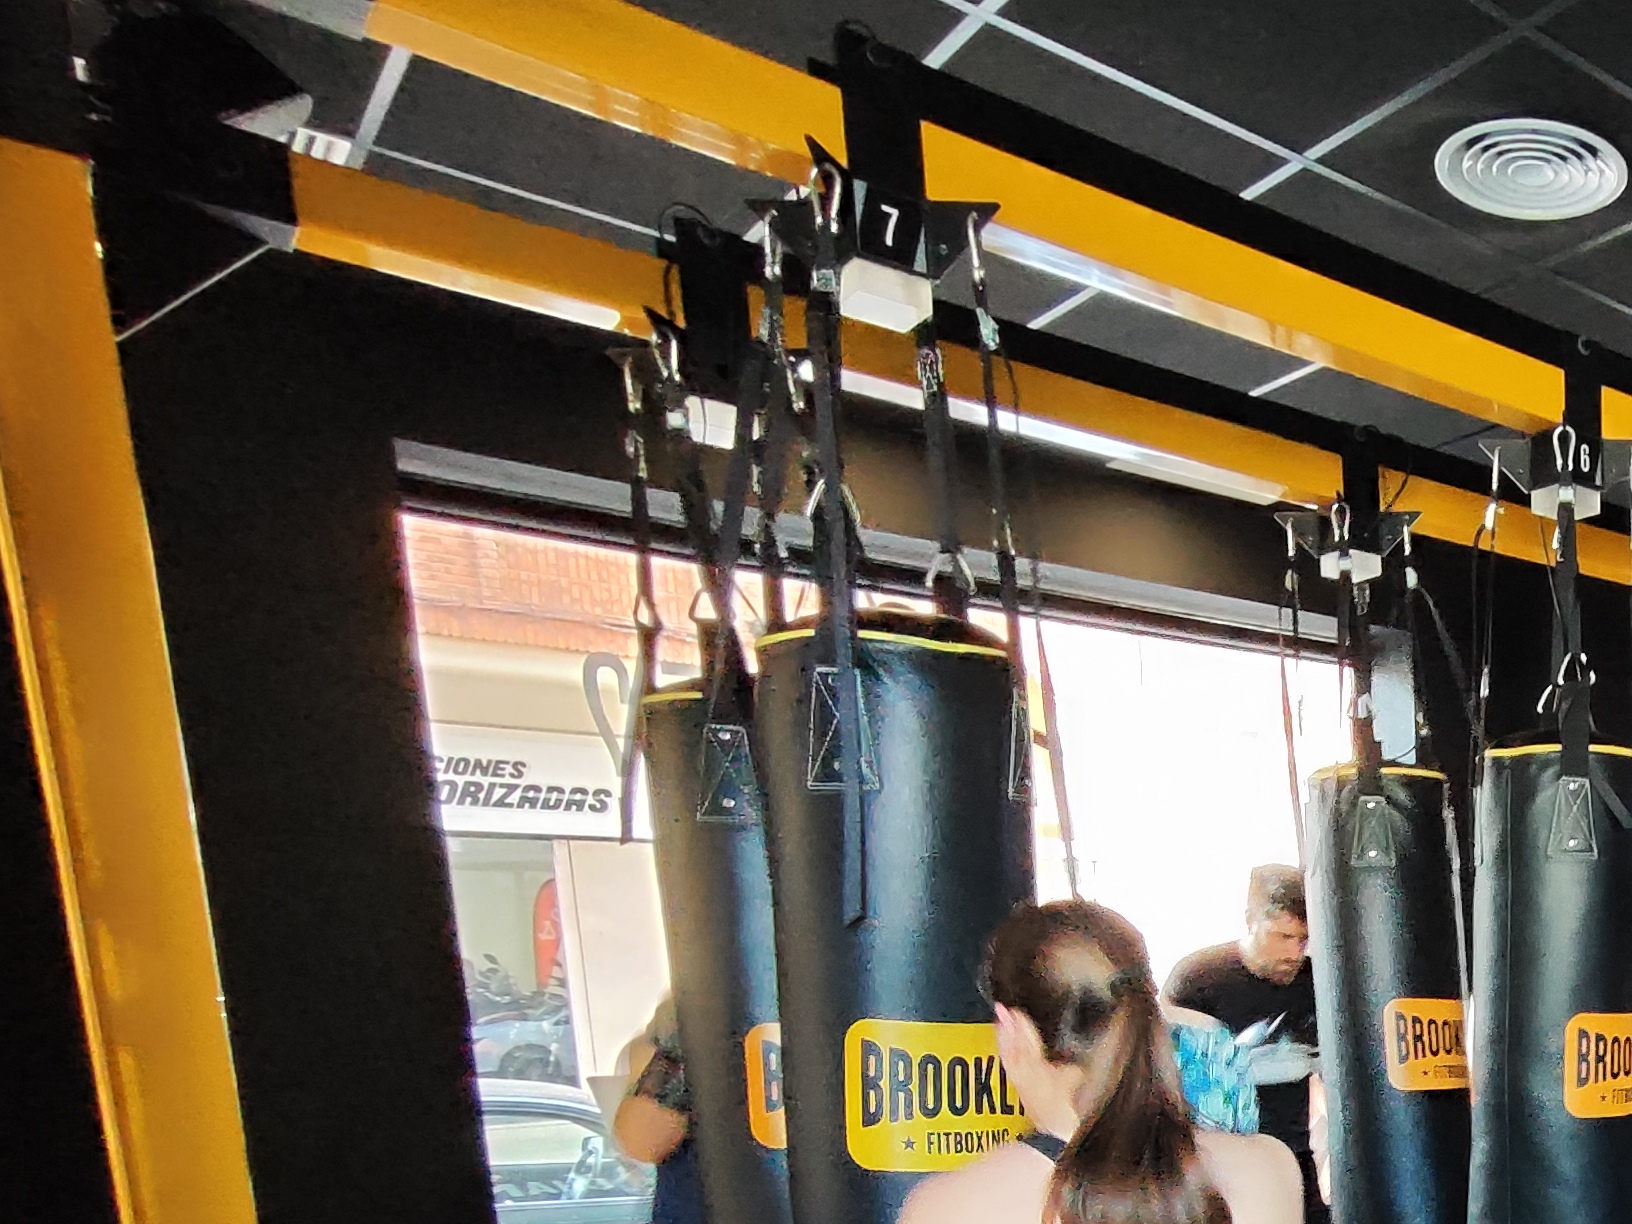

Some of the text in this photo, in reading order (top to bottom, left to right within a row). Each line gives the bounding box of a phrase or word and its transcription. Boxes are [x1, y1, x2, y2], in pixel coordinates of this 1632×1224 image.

[880, 204, 900, 247] 7
[1580, 444, 1590, 472] 6
[861, 1037, 1025, 1128] BROOKL
